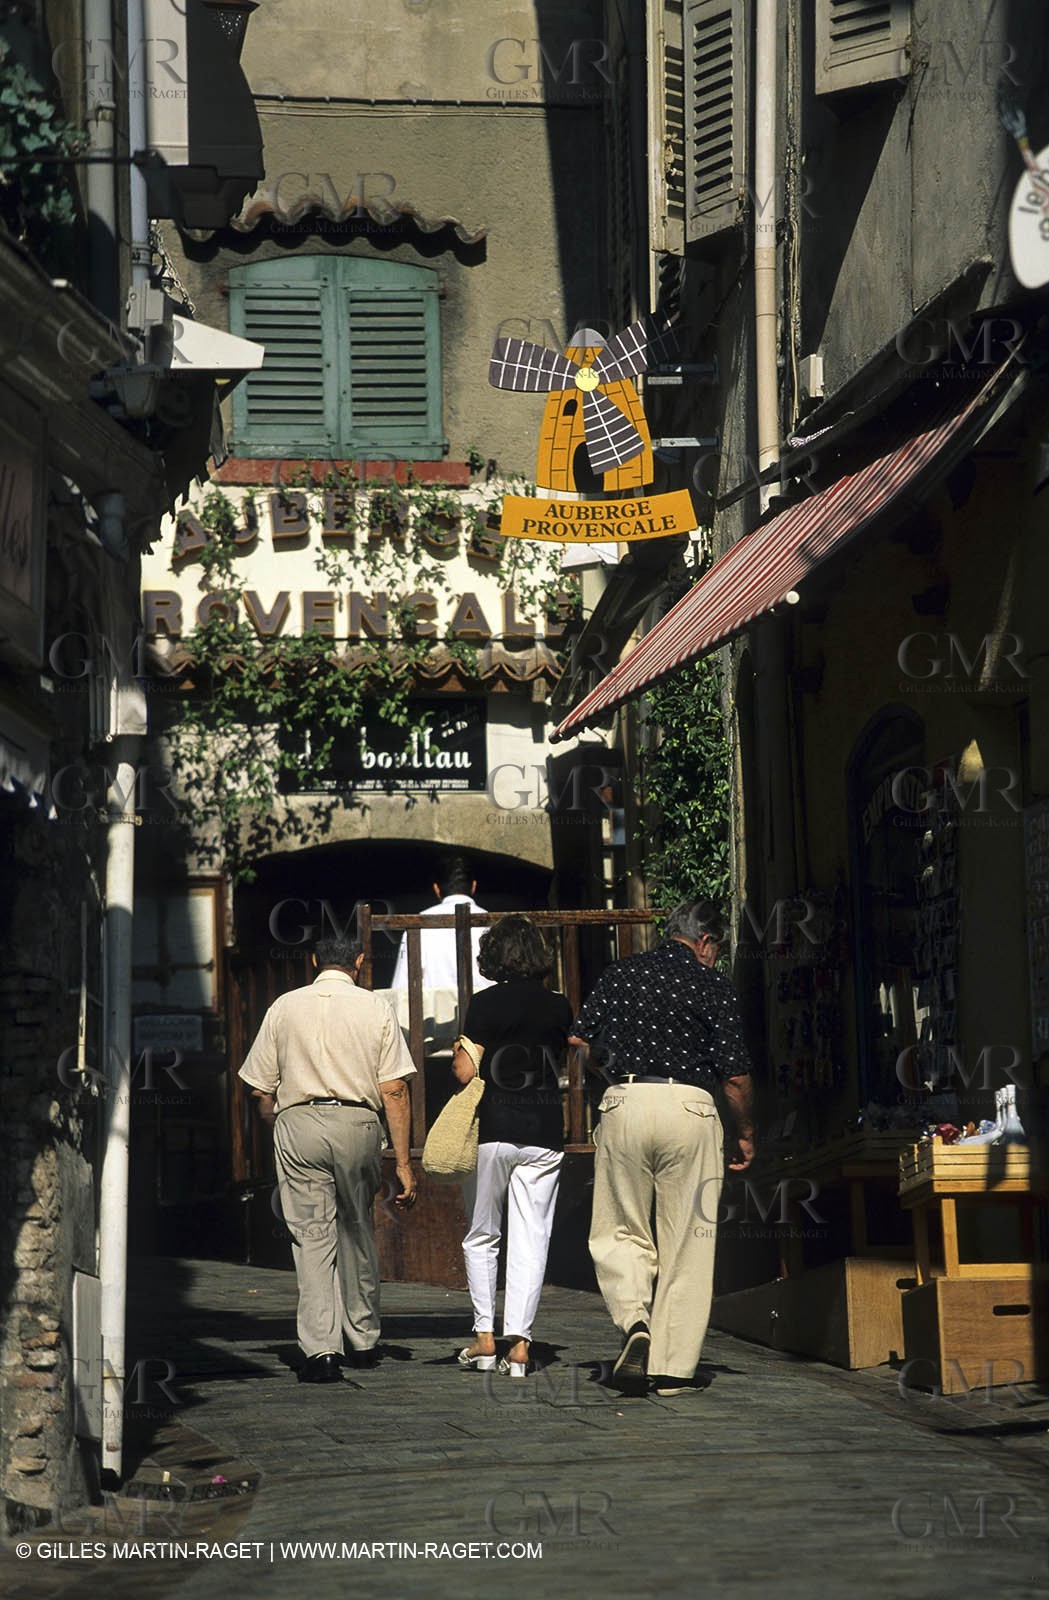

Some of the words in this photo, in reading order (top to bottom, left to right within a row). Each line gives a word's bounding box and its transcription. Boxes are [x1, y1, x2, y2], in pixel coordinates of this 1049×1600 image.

[544, 500, 652, 521] AUBERGE
[521, 514, 677, 538] PROVENCALE
[141, 589, 571, 637] ROVENCALE
